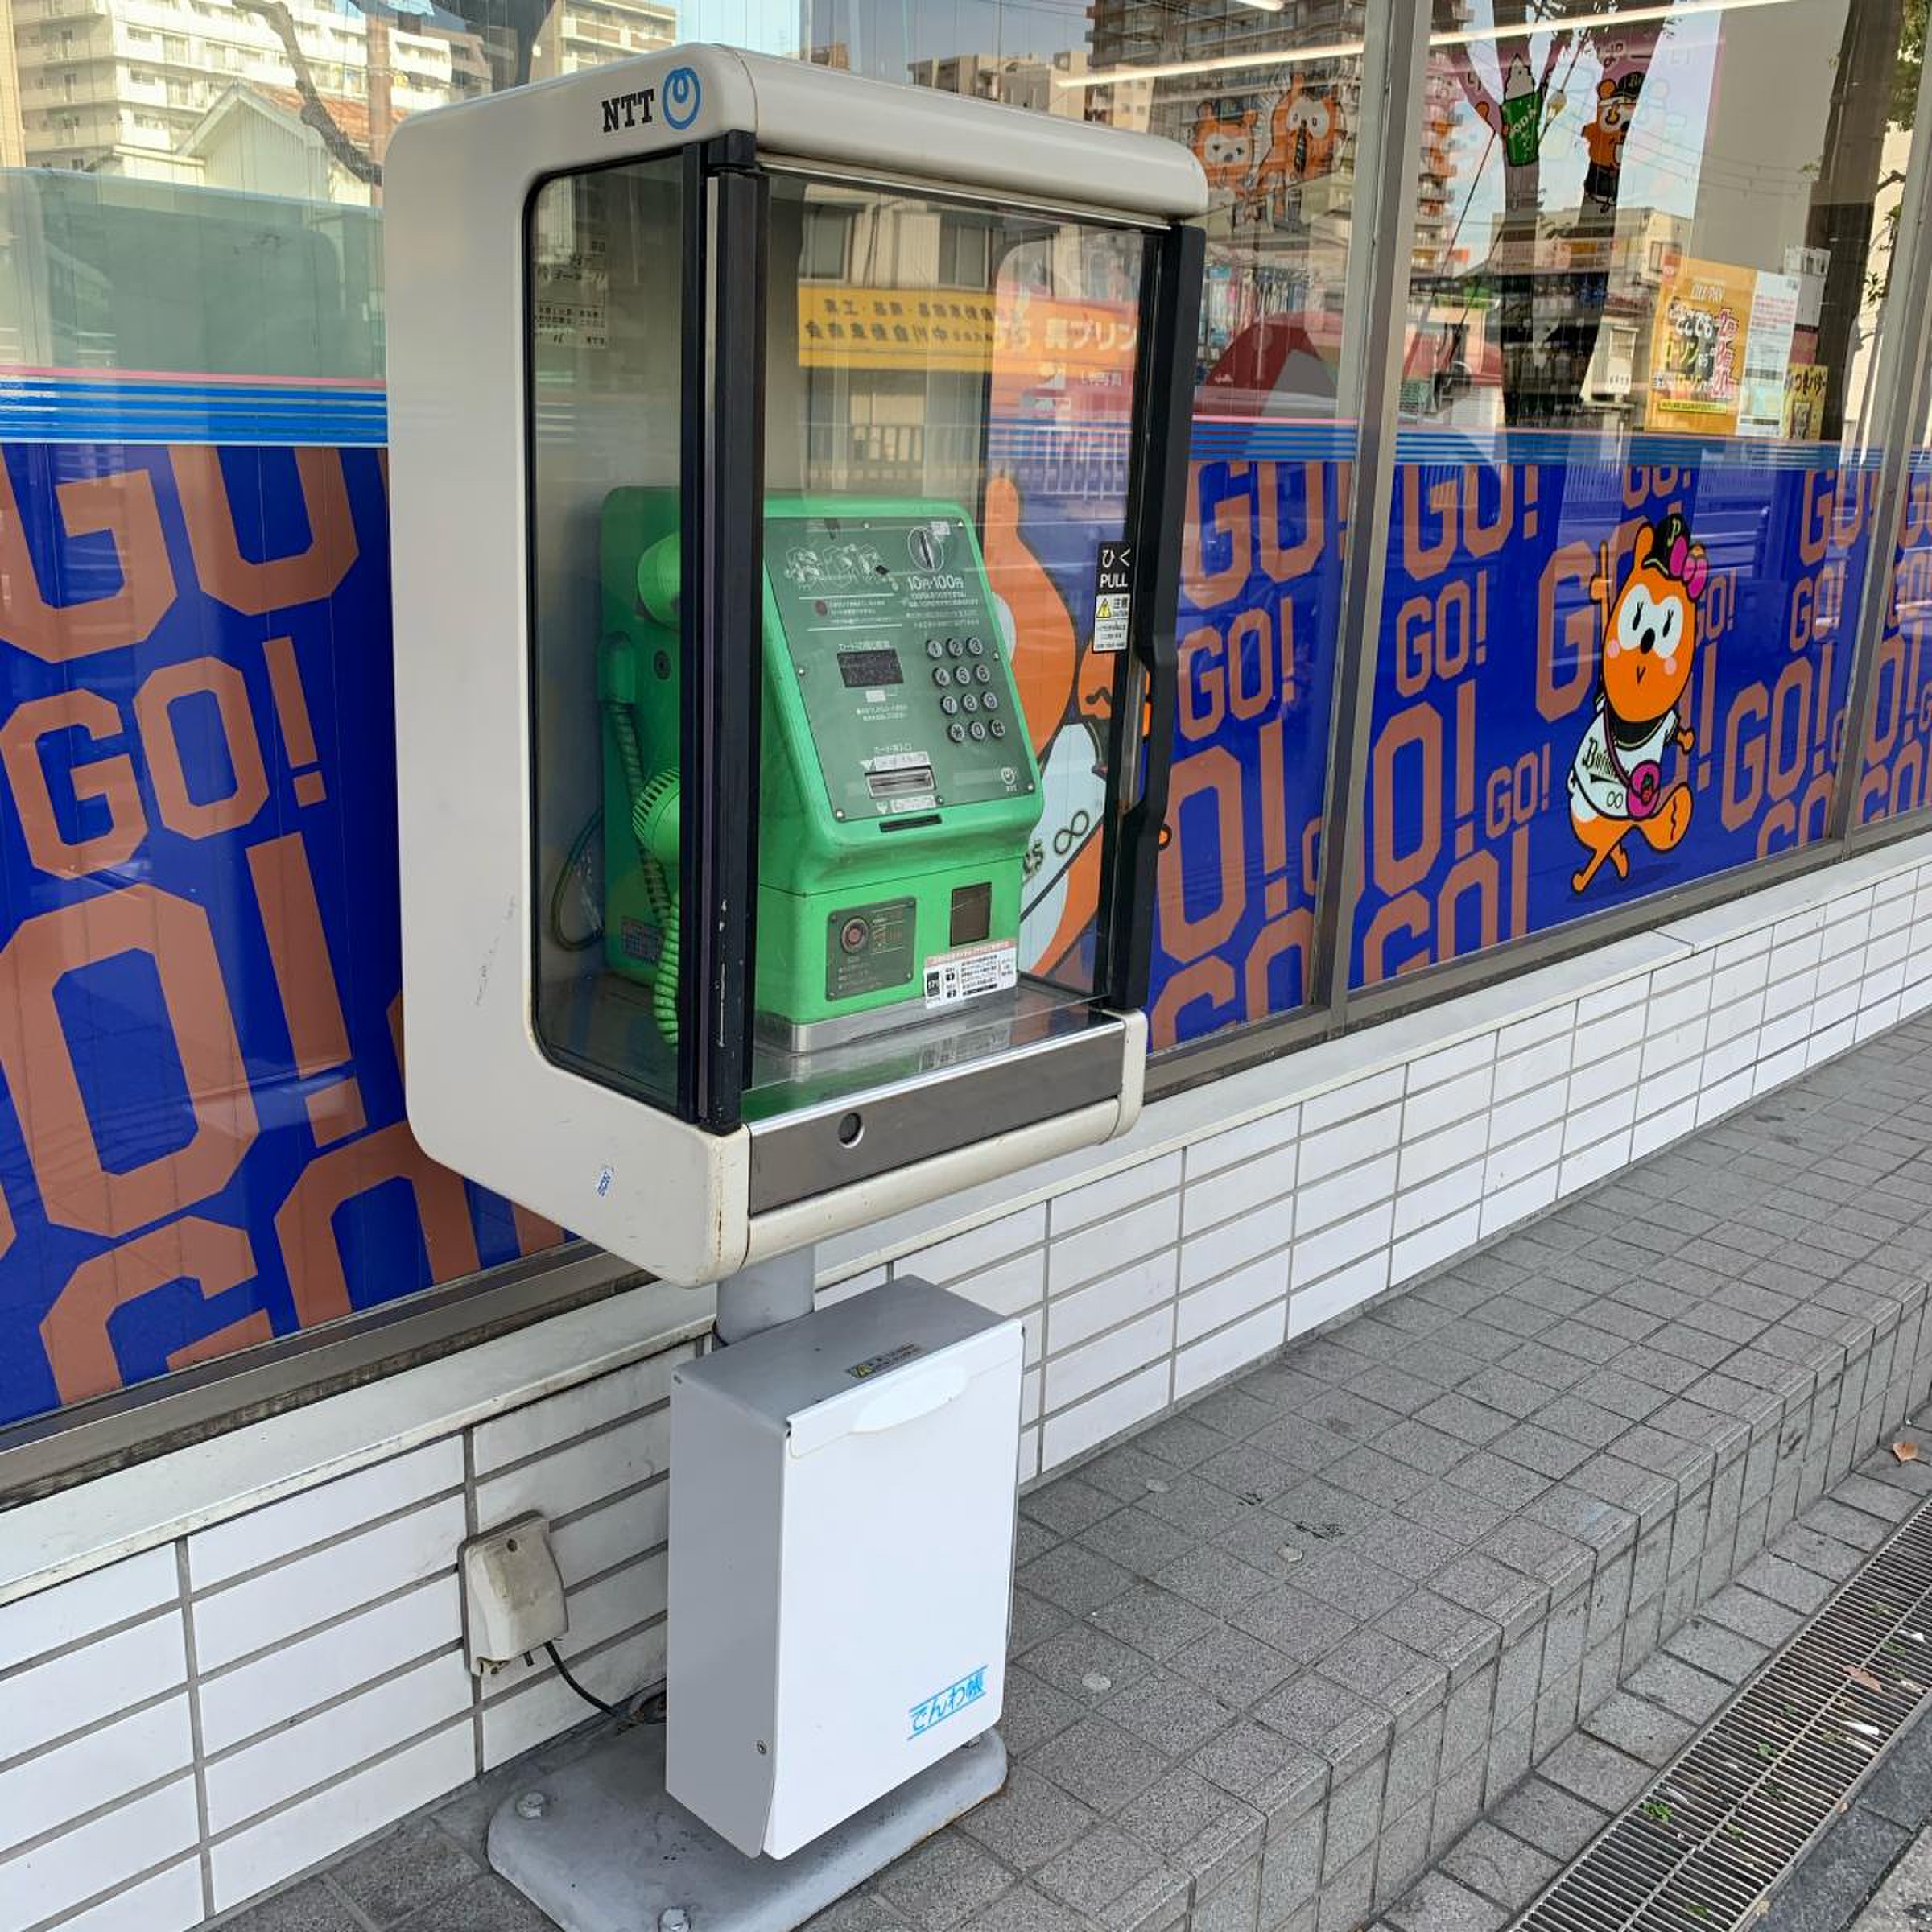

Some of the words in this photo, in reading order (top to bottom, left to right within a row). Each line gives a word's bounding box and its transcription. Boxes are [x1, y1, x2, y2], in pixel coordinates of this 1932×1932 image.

[601, 88, 654, 133] NTT
[1100, 572, 1128, 588] PULL
[1102, 548, 1131, 568] ひく
[1178, 597, 1294, 741] GO!
[1396, 570, 1487, 697] GO!
[0, 634, 327, 881] GO!
[1720, 644, 1834, 832] GO!
[1486, 743, 1550, 839] GO!
[910, 1670, 985, 1732] でんわ帳
